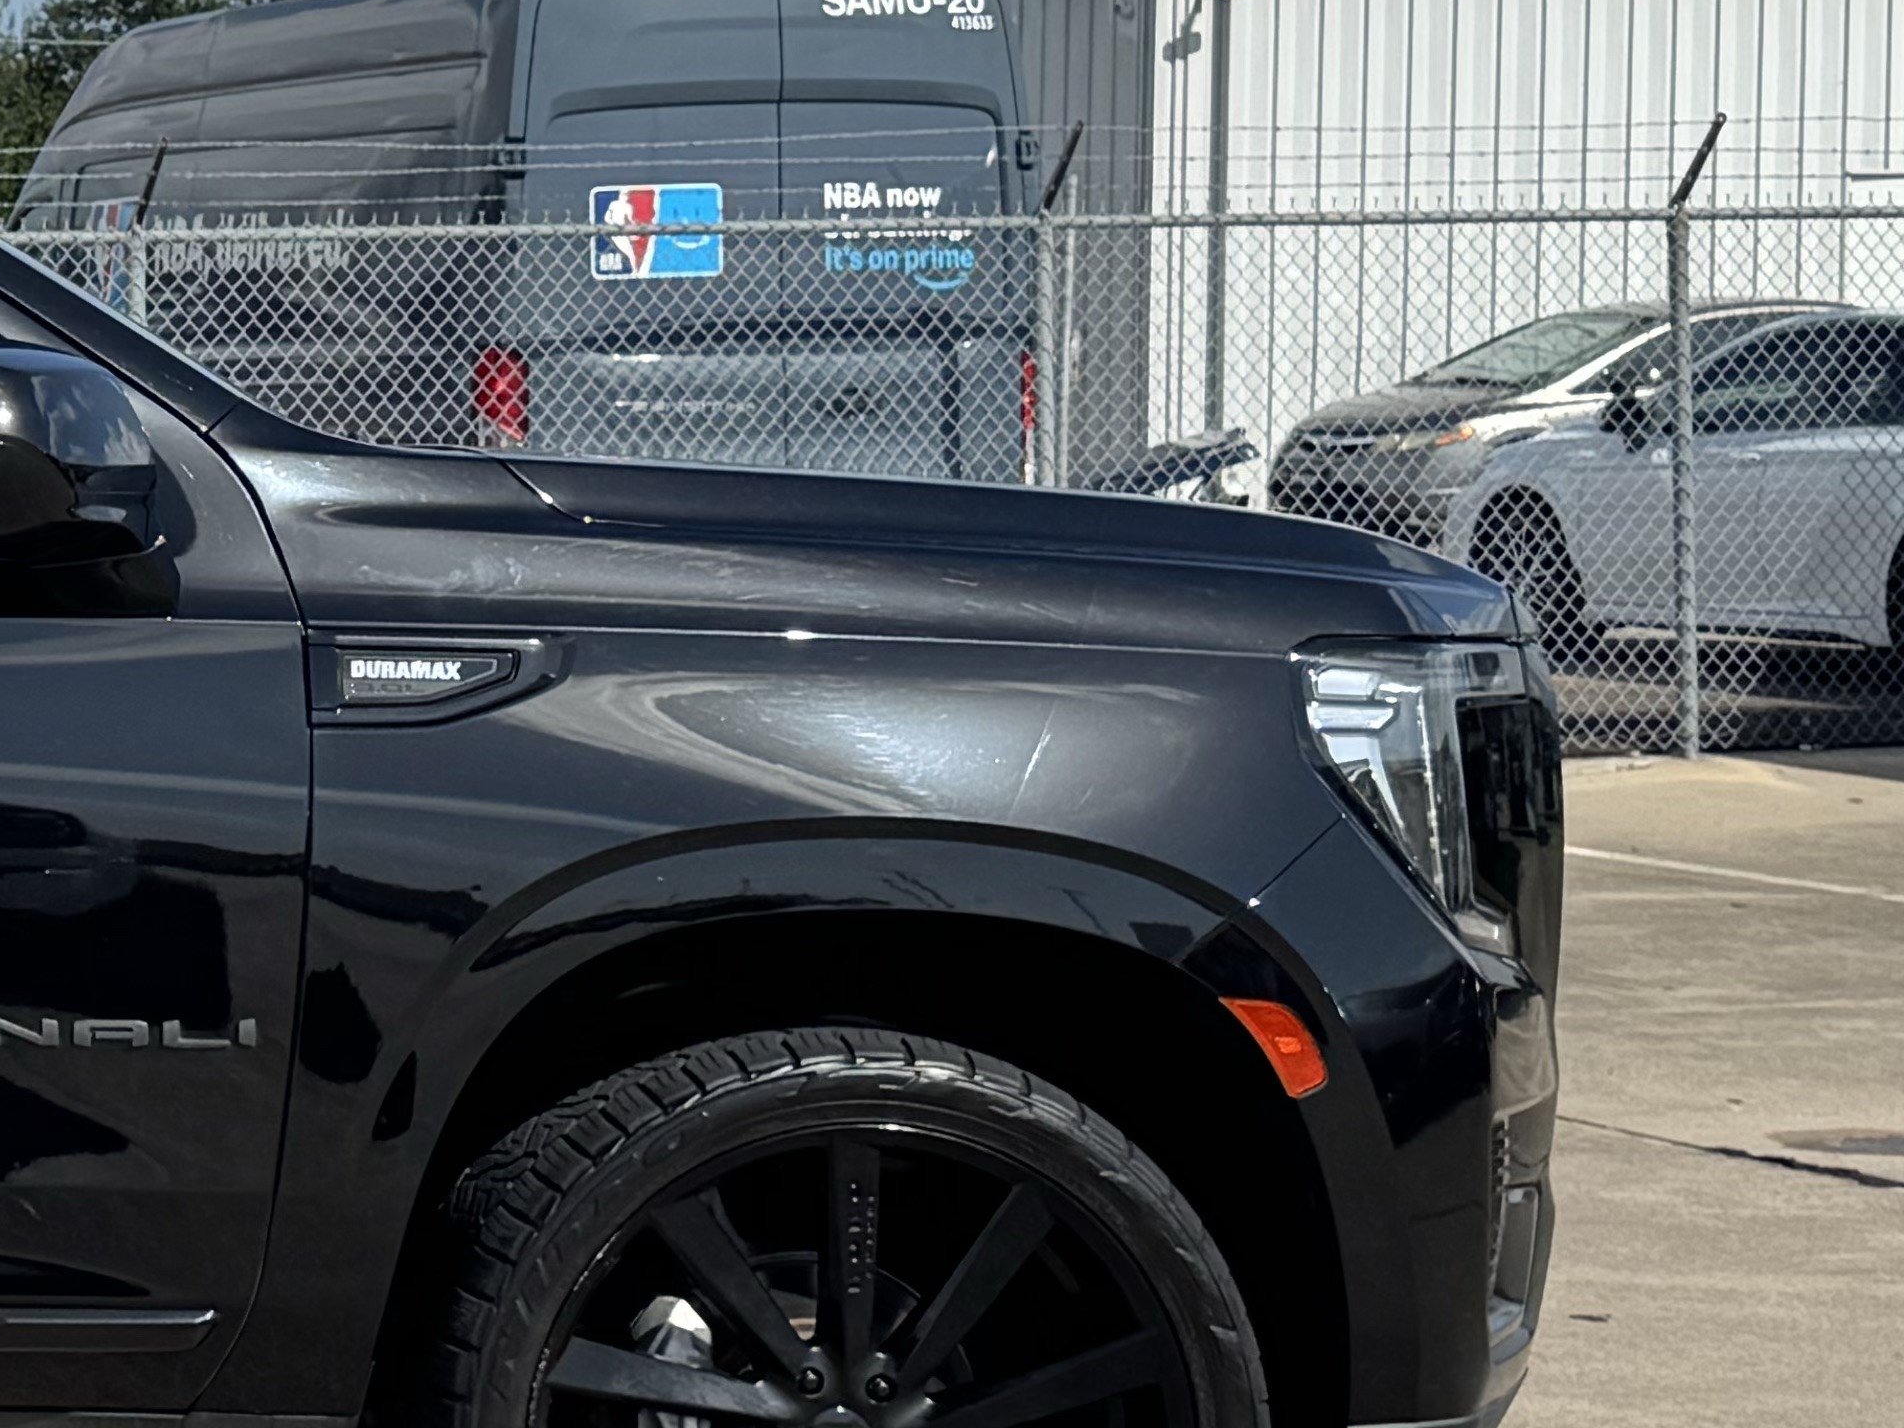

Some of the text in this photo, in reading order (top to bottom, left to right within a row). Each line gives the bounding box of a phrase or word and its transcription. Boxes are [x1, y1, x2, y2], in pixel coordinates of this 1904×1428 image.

[823, 181, 941, 209] NBA now
[824, 244, 975, 275] It's on prime
[350, 660, 461, 680] DURAMAX
